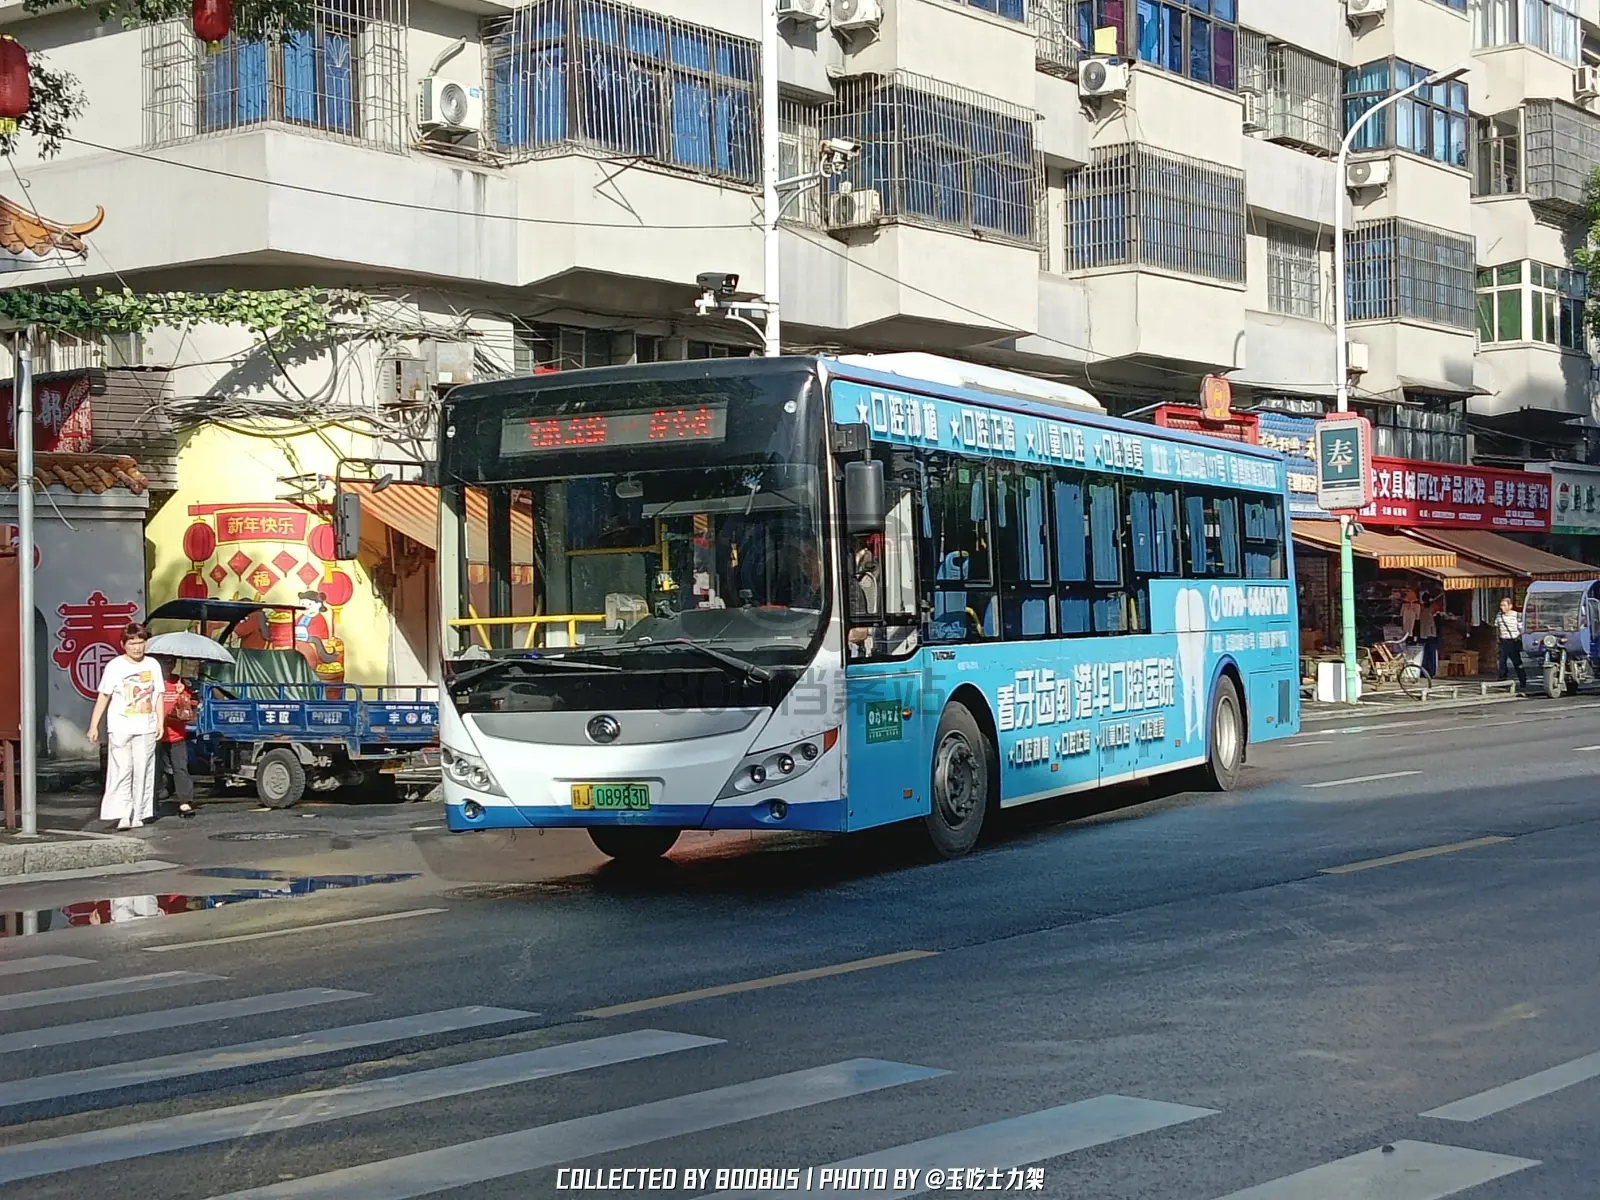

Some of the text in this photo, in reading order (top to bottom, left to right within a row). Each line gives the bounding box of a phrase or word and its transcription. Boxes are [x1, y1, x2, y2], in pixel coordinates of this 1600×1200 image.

[227, 516, 295, 535] 新年快乐
[253, 570, 271, 587] 福
